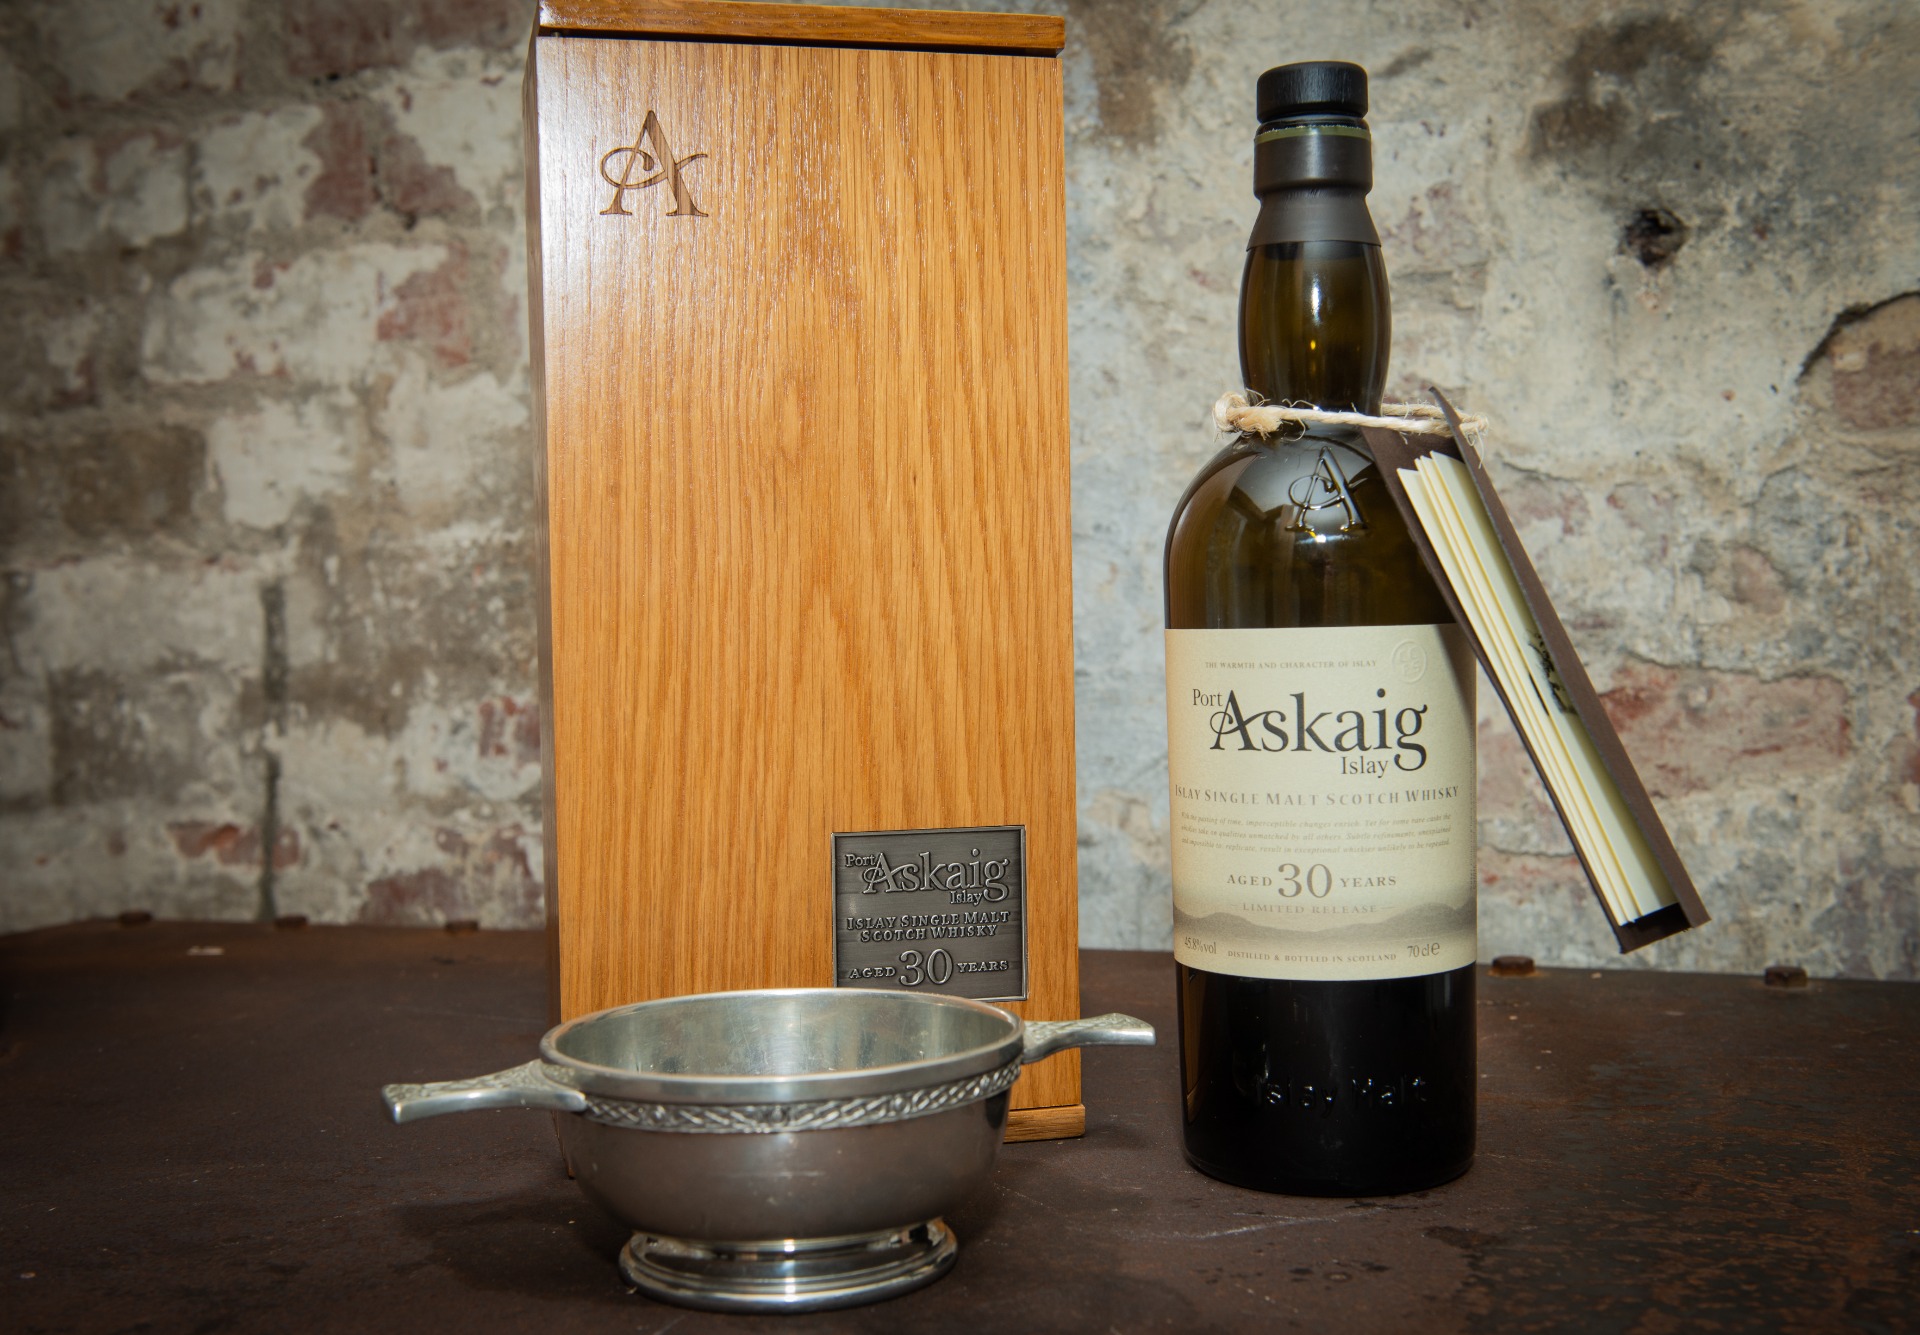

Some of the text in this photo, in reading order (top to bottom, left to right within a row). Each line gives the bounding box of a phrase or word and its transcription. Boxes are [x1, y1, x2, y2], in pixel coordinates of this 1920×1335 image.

[1205, 661, 1217, 669] THE
[1280, 661, 1334, 669] CHARACTER
[1338, 660, 1349, 668] OF
[1192, 687, 1428, 772] Port Askaig
[1340, 755, 1389, 778] Islay
[1266, 793, 1320, 806] MALT
[1326, 792, 1399, 806] SCOTCH
[1405, 786, 1459, 802] WHISKY
[844, 848, 1010, 902] Port Askaig
[1226, 863, 1397, 898] AGED 30 YEARS
[949, 890, 983, 906] Islay
[1243, 903, 1377, 914] LIMITED RELEASE
[847, 911, 1010, 930] ISLAY SINGLE MALT
[860, 924, 998, 943] SCOTCH WHISKY
[1227, 950, 1270, 961] DISTILLED
[1285, 954, 1328, 963] BOTTLED
[1332, 954, 1343, 963] IN
[1347, 953, 1397, 962] SCOTLAND
[849, 948, 1009, 986] AGED 30 YEARS
